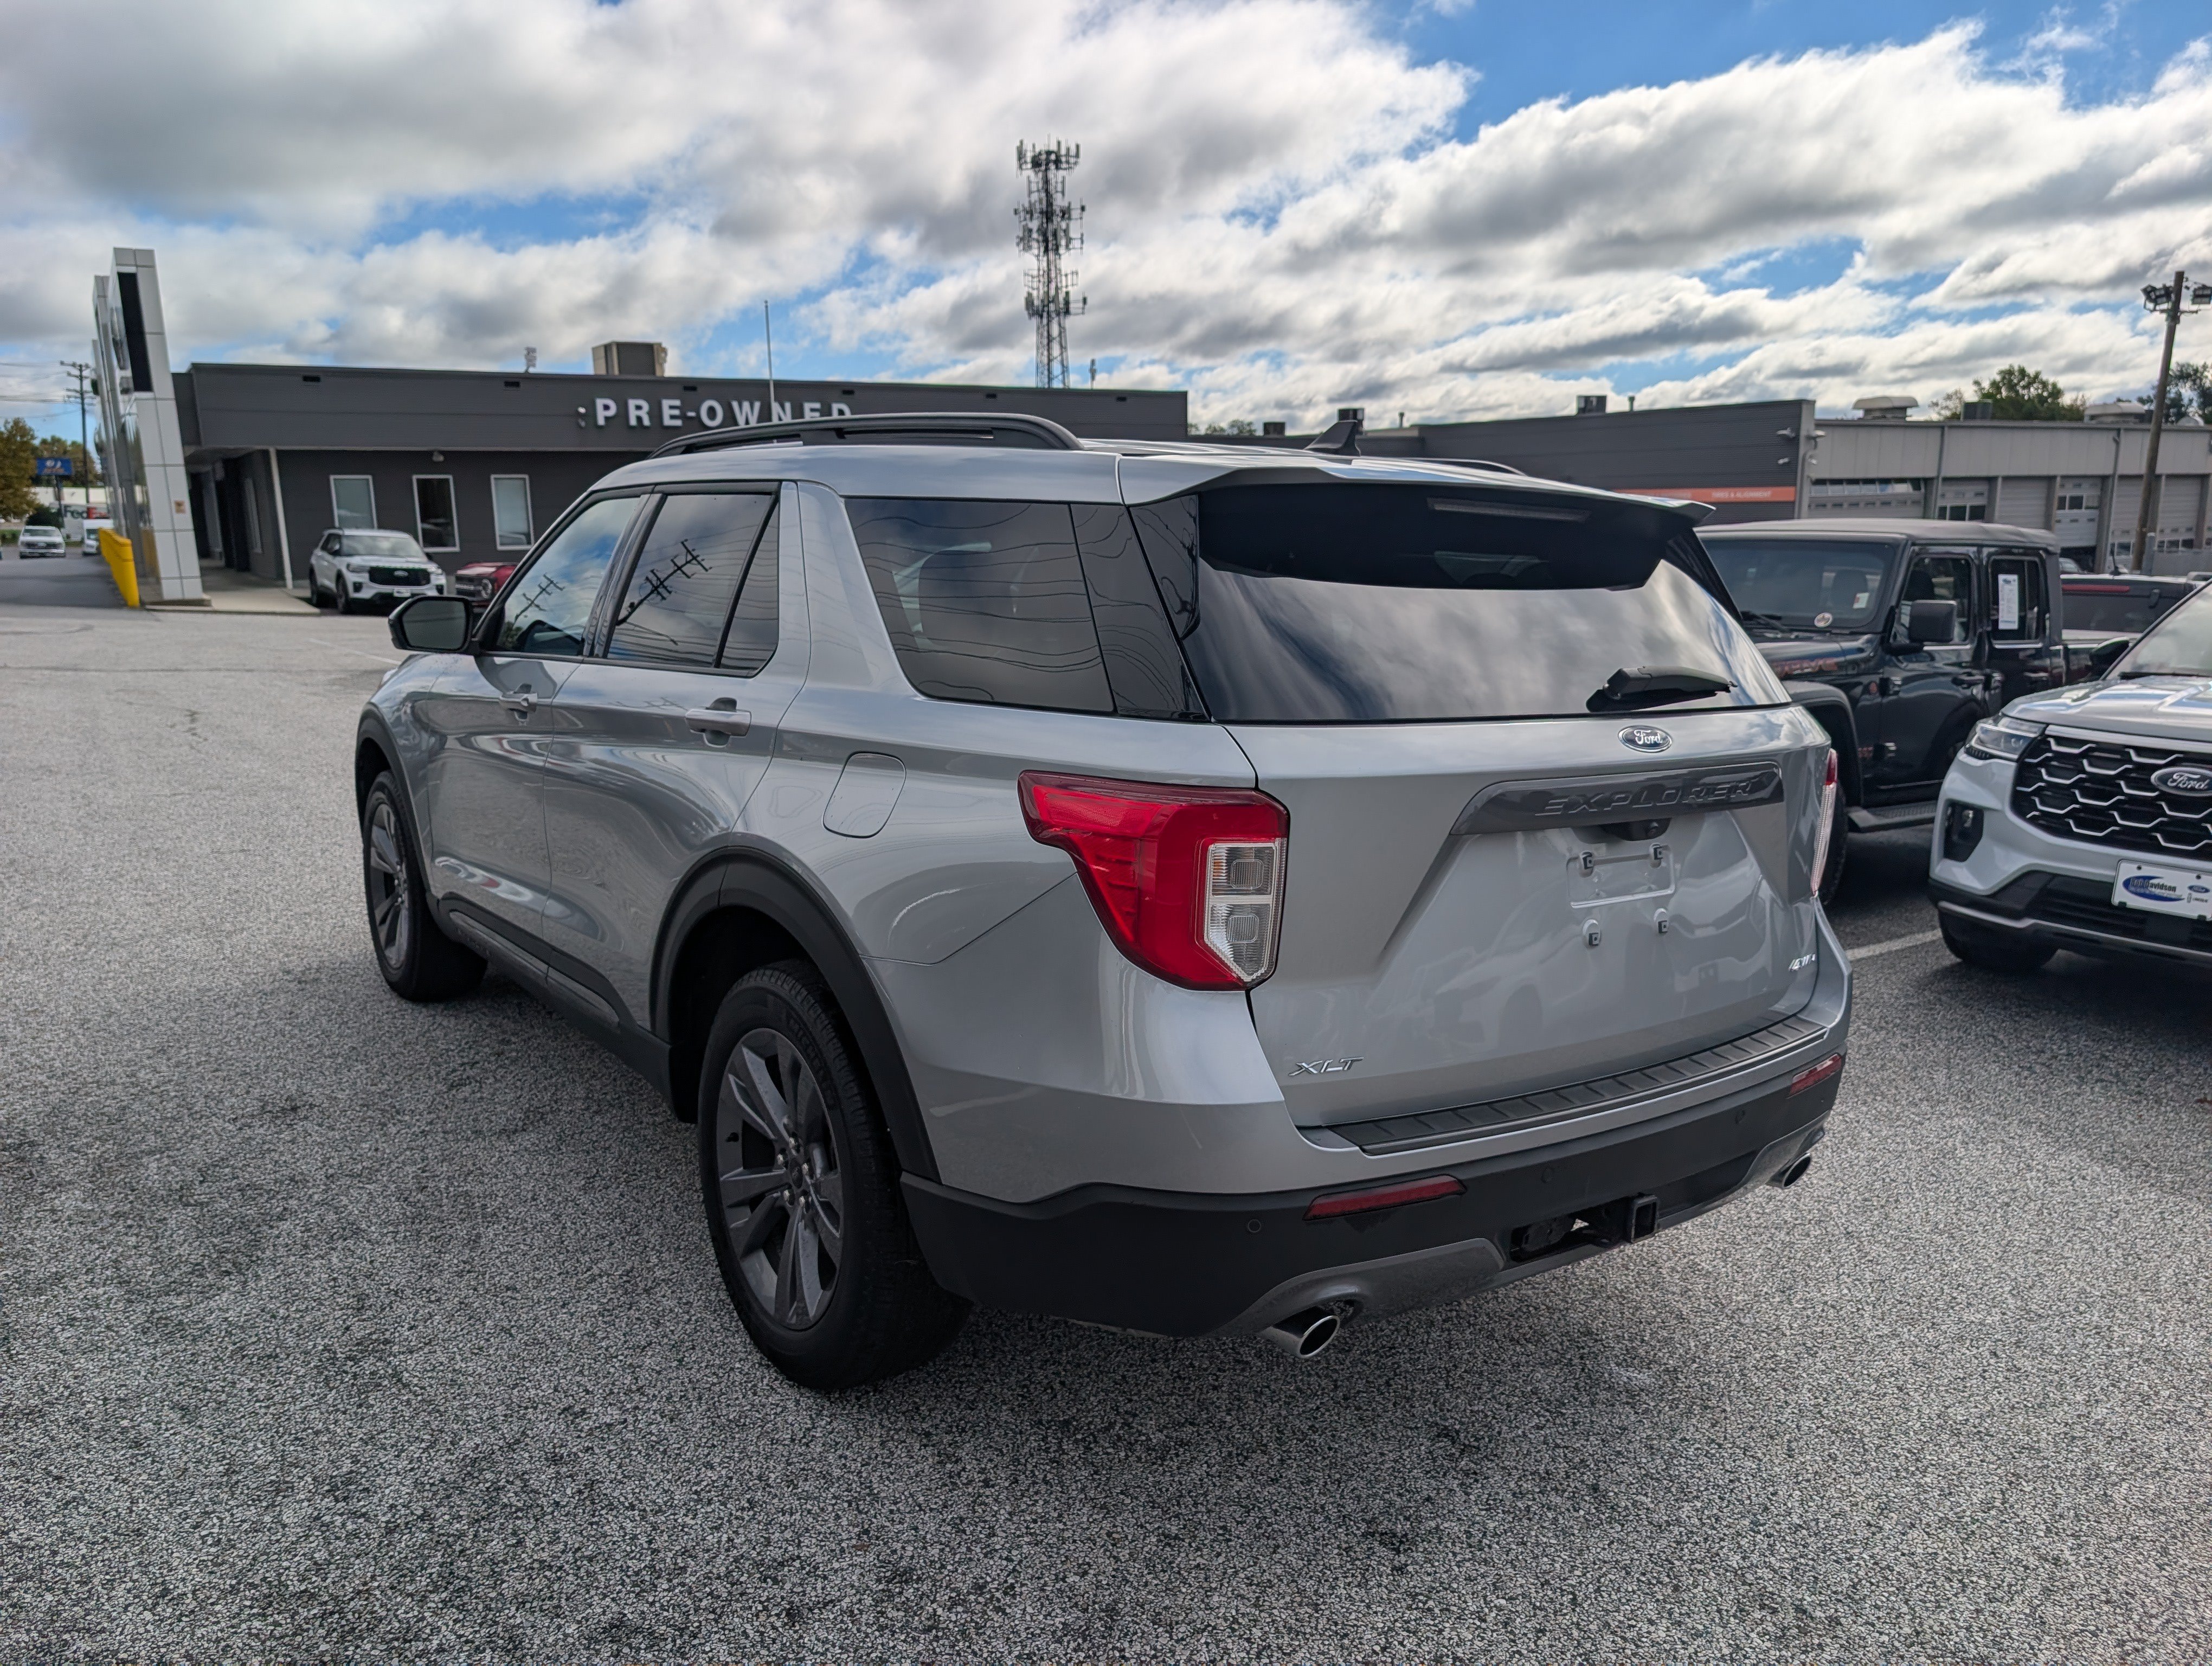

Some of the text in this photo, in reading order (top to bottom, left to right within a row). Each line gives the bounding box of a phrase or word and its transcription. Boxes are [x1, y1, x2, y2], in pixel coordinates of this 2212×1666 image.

[595, 398, 852, 427] PRE-OWNED
[1634, 729, 1663, 745] Ford
[2167, 772, 2210, 790] Ford
[1534, 779, 1754, 816] EXPLORER
[2144, 879, 2177, 893] Davidson
[1288, 1056, 1365, 1077] XLT
